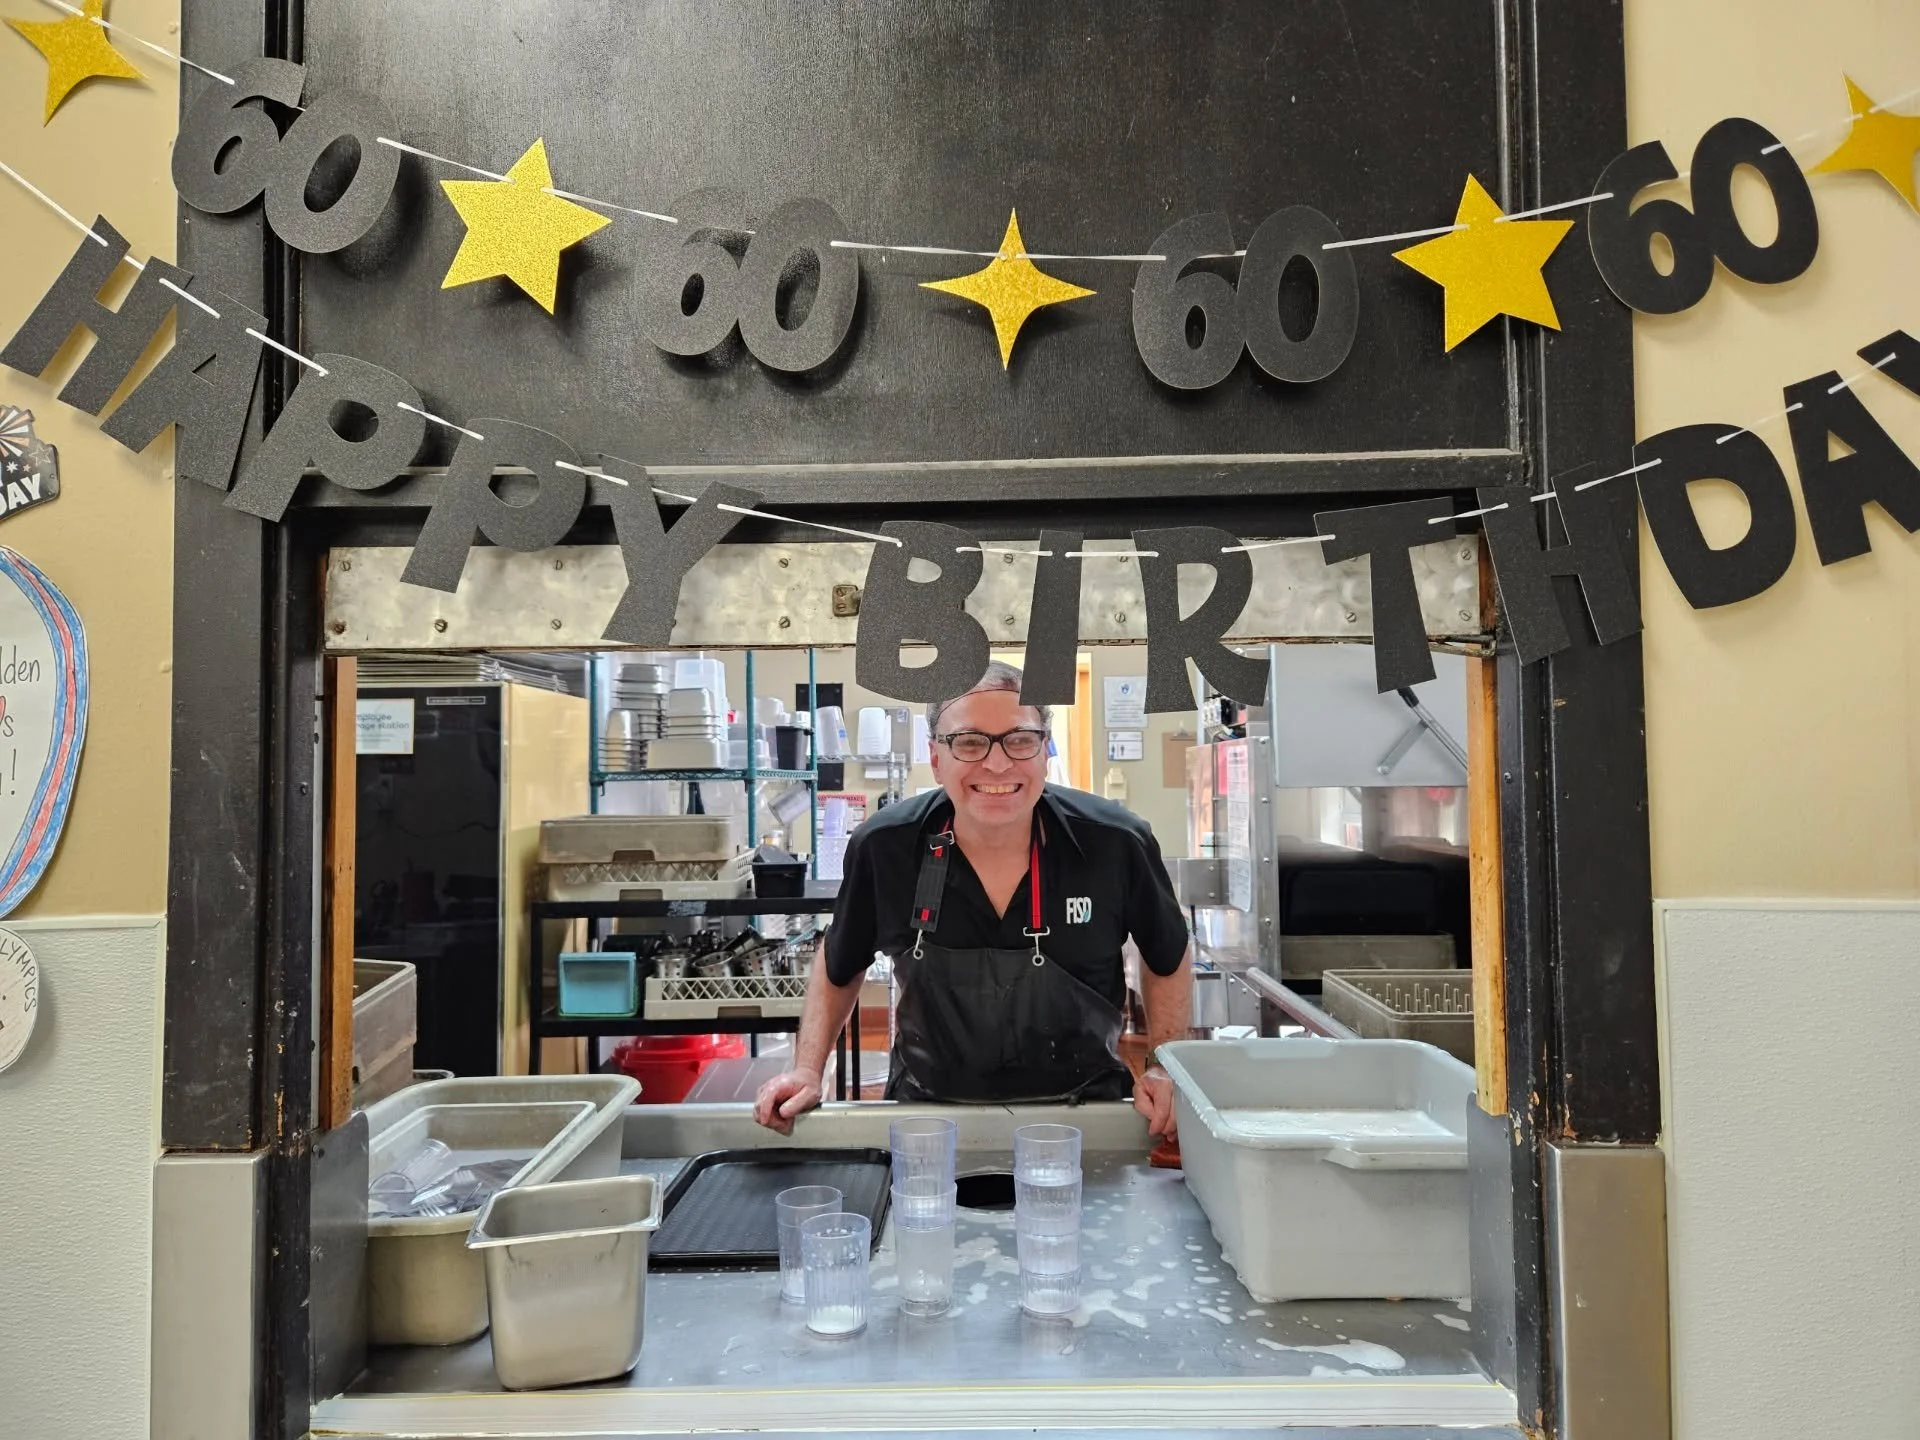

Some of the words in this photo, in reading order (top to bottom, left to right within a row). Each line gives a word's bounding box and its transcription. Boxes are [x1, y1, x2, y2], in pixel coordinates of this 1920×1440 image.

[172, 57, 401, 253] 60
[635, 187, 859, 372] 60
[1132, 204, 1359, 389] 60
[1588, 117, 1819, 315] 60
[0, 213, 766, 648] HAPPY
[1066, 896, 1092, 924] FISD
